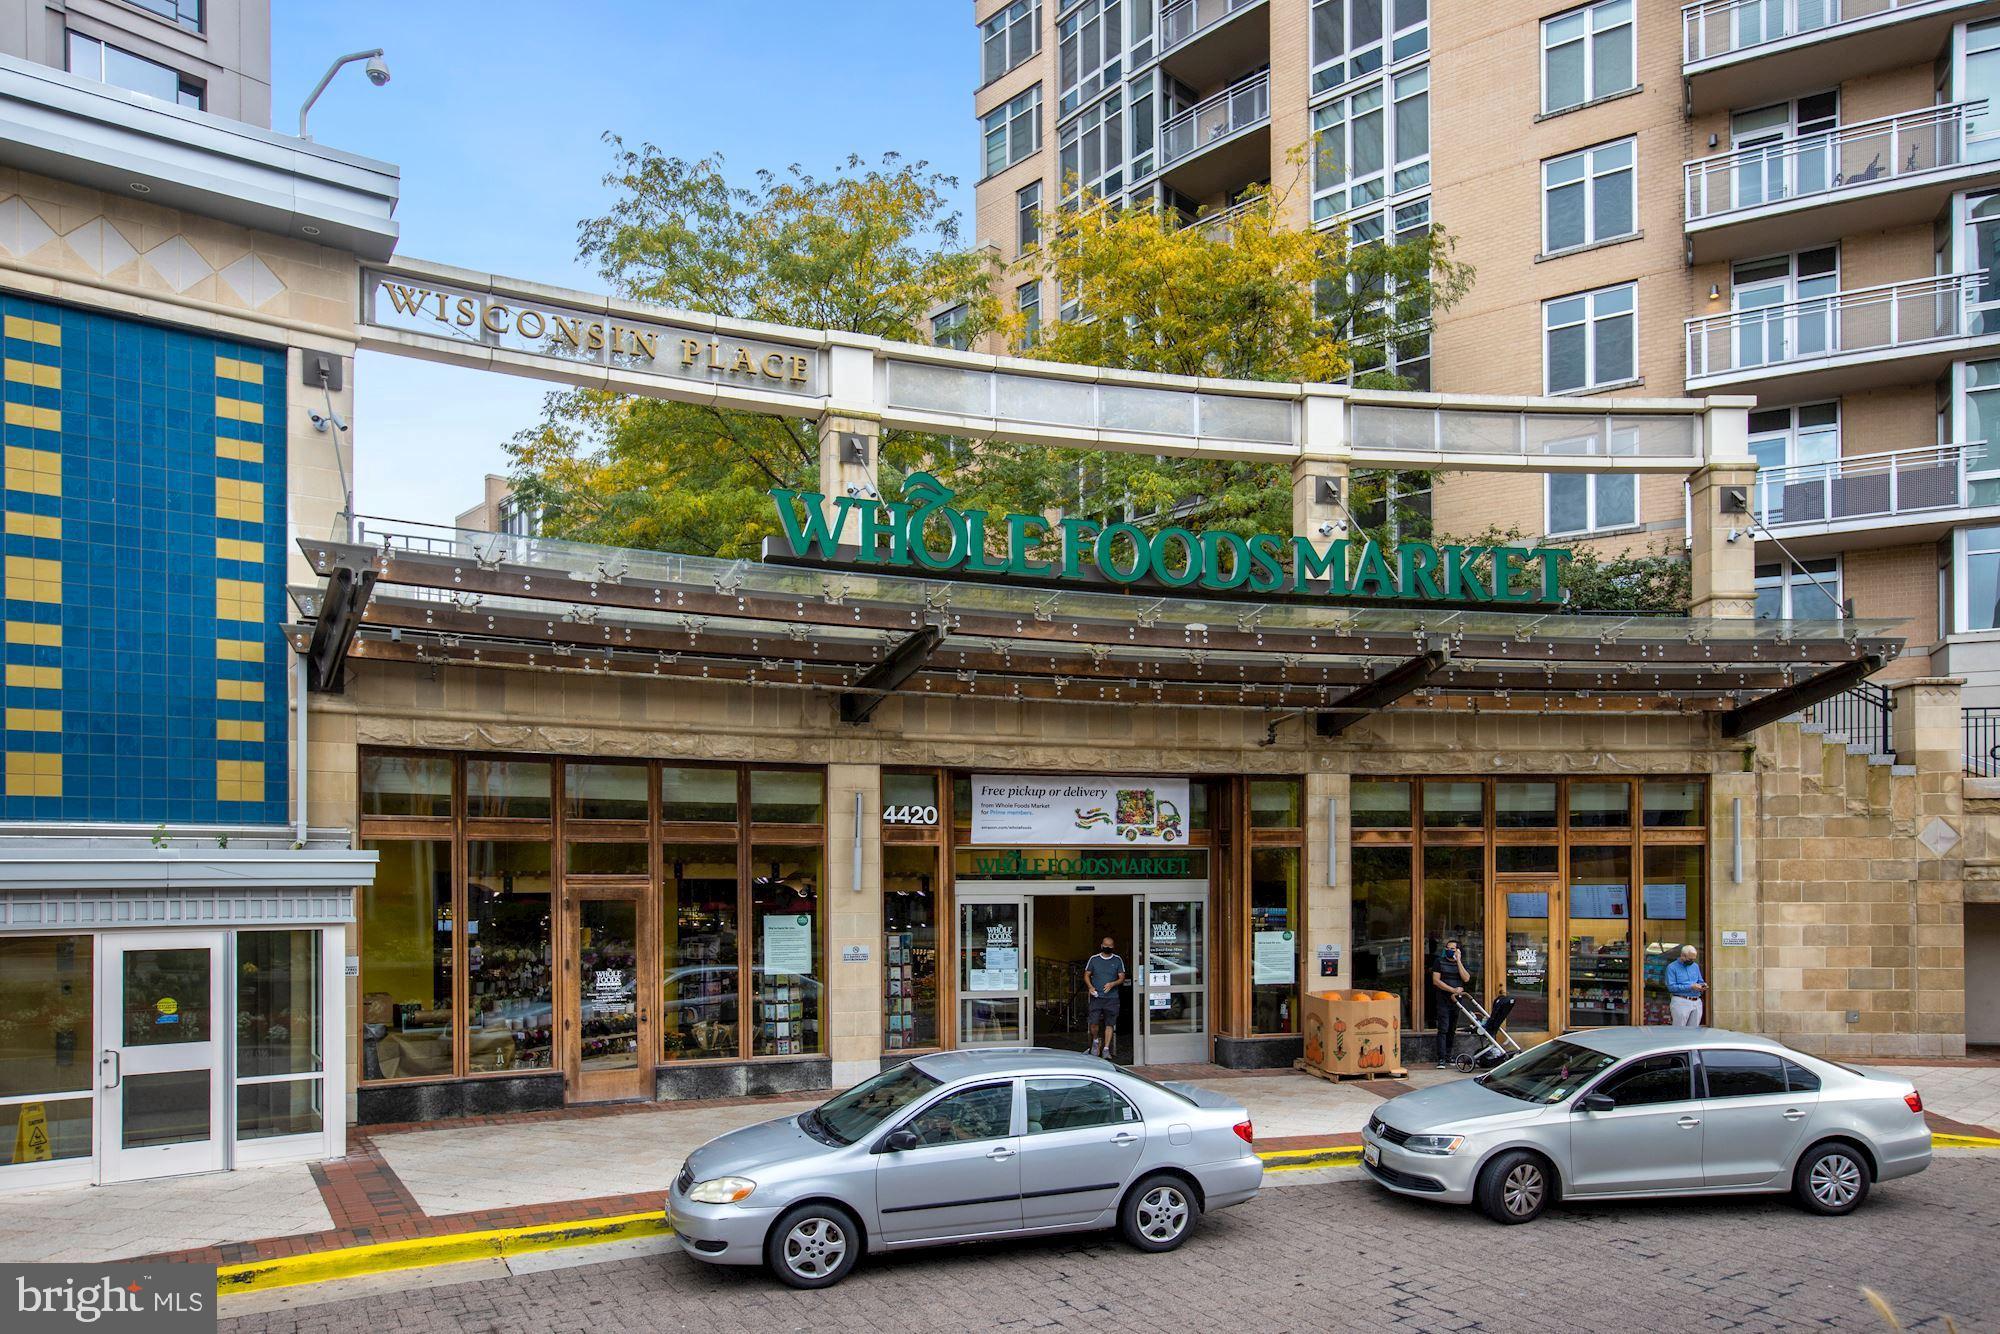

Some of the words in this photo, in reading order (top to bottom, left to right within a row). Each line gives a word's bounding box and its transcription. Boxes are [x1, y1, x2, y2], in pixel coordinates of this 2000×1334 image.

[382, 283, 659, 360] WISCONSIN
[681, 339, 809, 383] PLACE
[767, 472, 1052, 578] WHOLE
[1058, 518, 1285, 593] FOODS
[1290, 536, 1573, 602] MARKET
[981, 785, 1006, 796] Free
[1008, 785, 1046, 798] pickup
[1048, 788, 1061, 797] or
[1063, 786, 1108, 799] delivery
[882, 805, 938, 825] 4420
[976, 850, 1045, 875] WHOLE
[1047, 857, 1109, 875] FOODS
[1111, 856, 1189, 875] MARKET
[986, 924, 1013, 934] WHOLE
[1152, 922, 1177, 931] WHOLE
[595, 968, 622, 977] WHOLE
